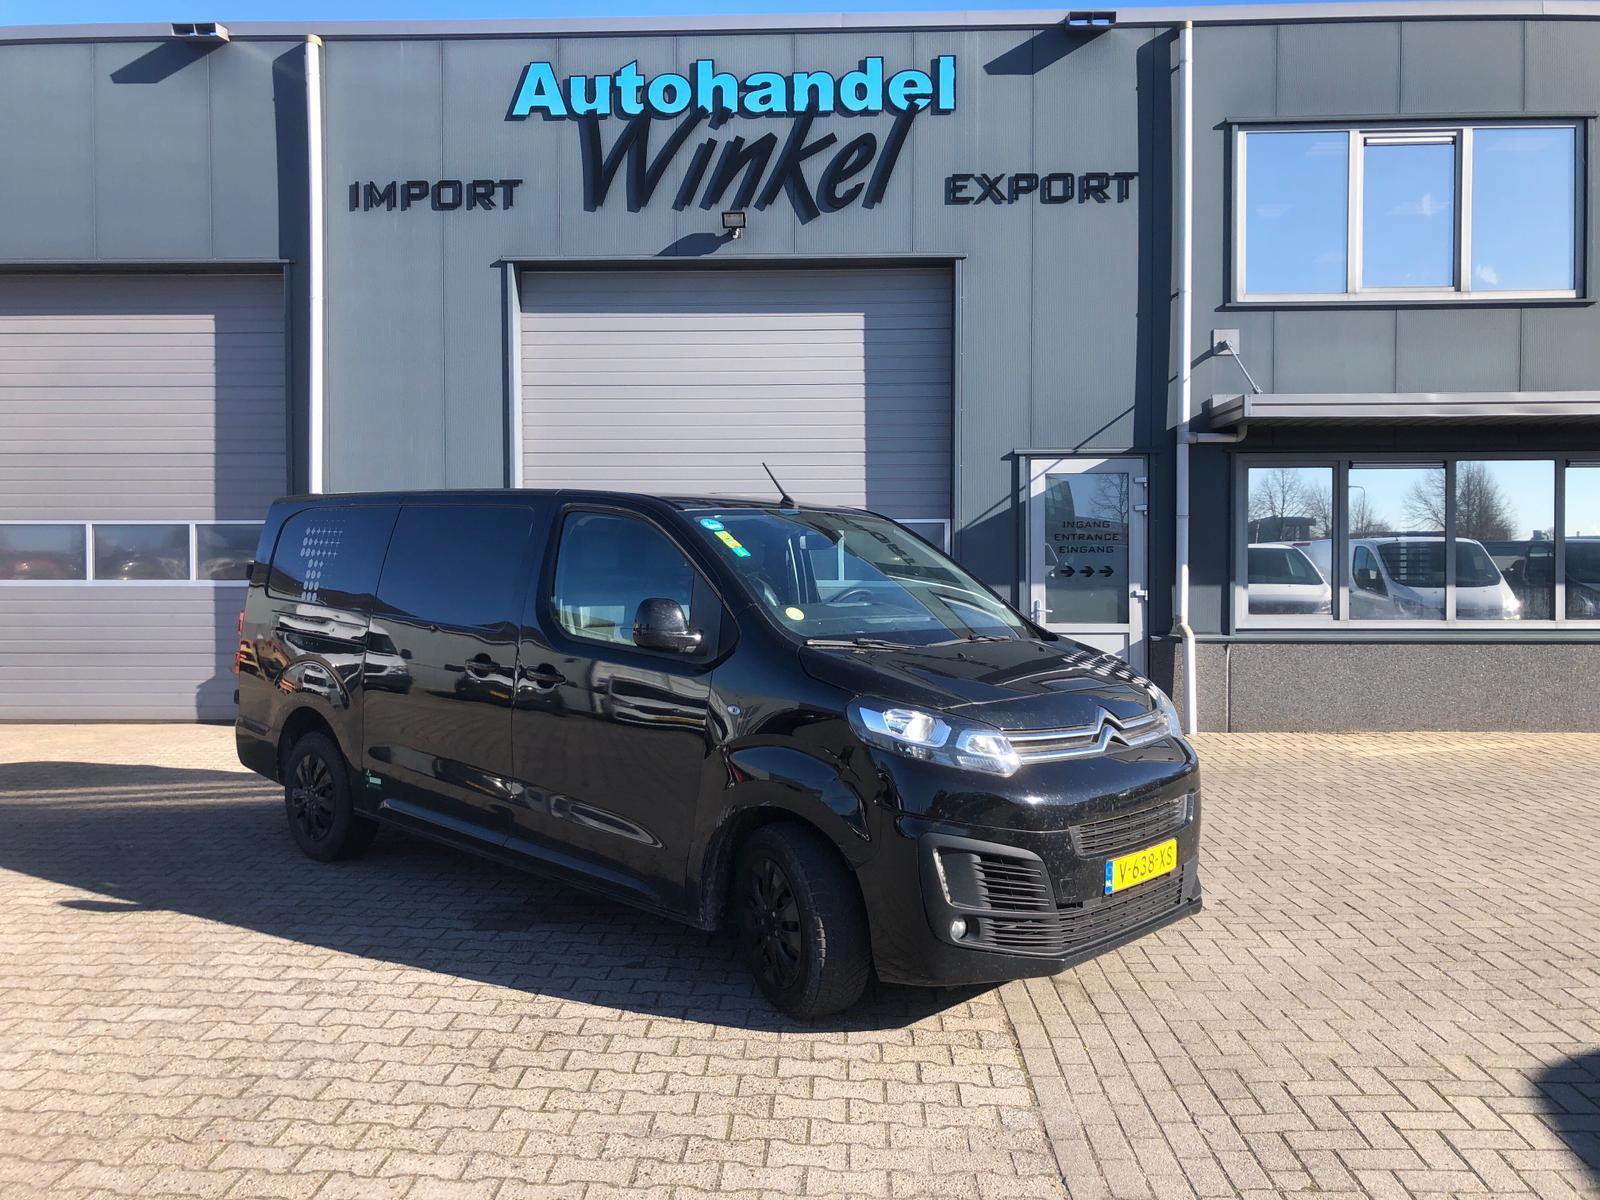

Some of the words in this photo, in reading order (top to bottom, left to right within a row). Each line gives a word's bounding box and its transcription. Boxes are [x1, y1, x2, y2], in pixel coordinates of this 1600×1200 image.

[508, 54, 956, 120] Autohandel
[577, 102, 921, 225] Winkel
[349, 179, 523, 212] IMPORT
[944, 172, 1139, 205] EXPORT
[1054, 533, 1119, 542] ENTRANCE
[1062, 520, 1111, 529] INGANG
[1059, 545, 1114, 554] EINGANG
[1119, 846, 1173, 883] V-638-XS
